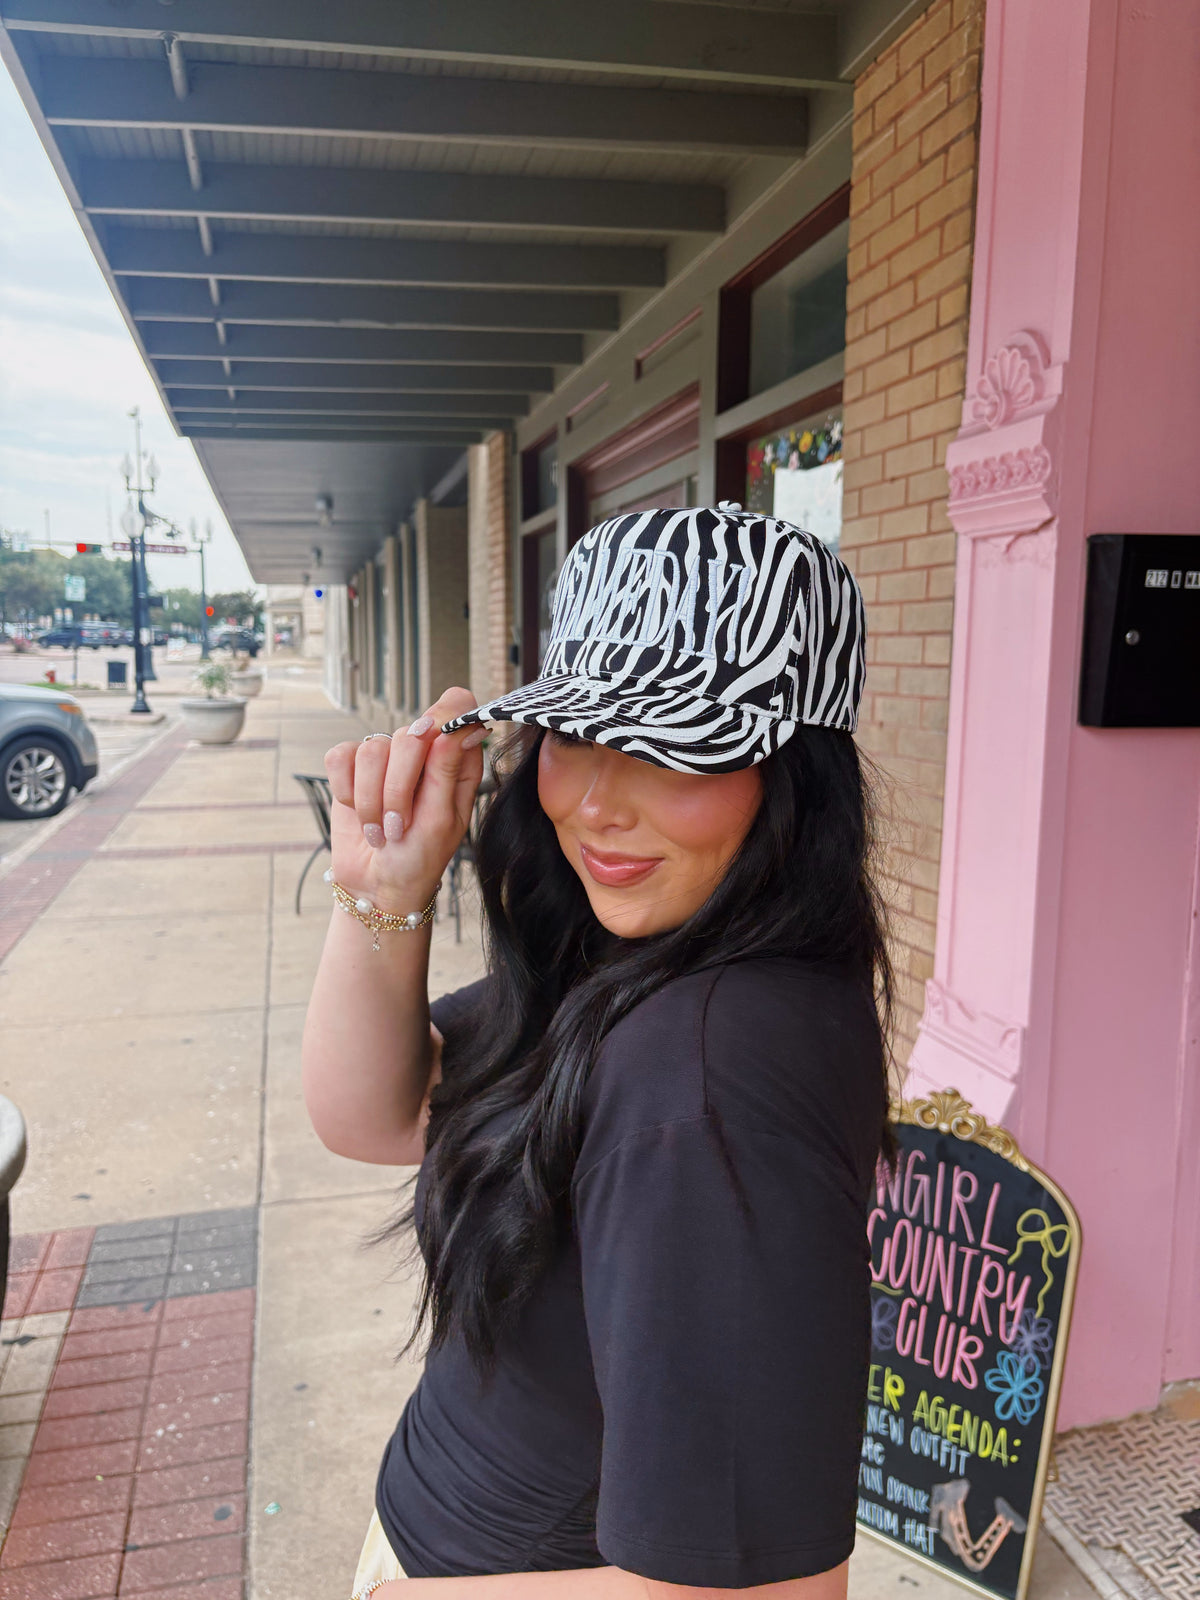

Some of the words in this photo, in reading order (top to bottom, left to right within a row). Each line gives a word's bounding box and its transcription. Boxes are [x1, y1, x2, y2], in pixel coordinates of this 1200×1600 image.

[867, 1208, 1032, 1344] COUNTRY
[896, 1297, 984, 1389] CLUB
[910, 1426, 971, 1476] OUTFIT
[912, 1390, 1021, 1467] AGENDA:
[902, 1518, 939, 1556] HAT
